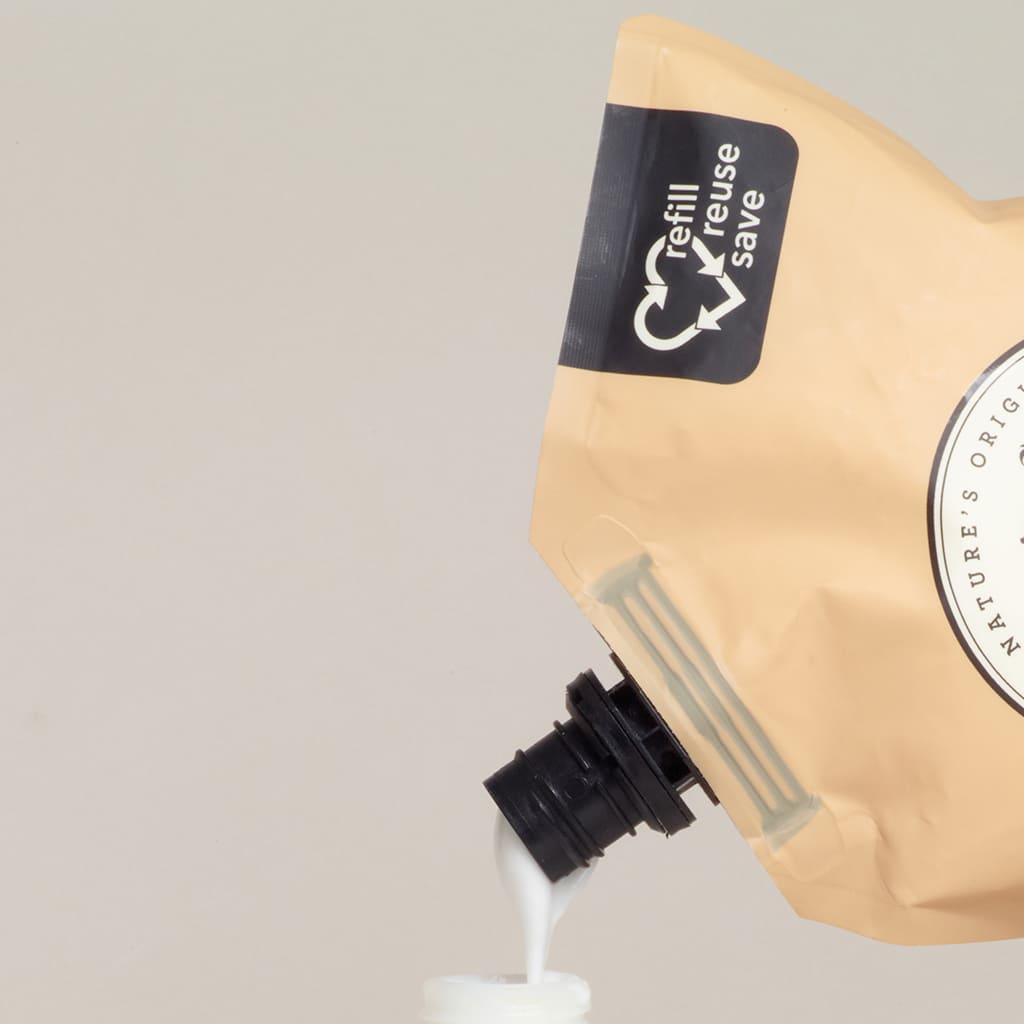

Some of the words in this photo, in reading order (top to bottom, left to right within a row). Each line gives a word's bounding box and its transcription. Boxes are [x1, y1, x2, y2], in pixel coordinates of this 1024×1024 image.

[664, 183, 700, 258] refill
[703, 143, 740, 236] reuse
[731, 189, 765, 268] save
[961, 489, 1021, 656] NATURE'S
